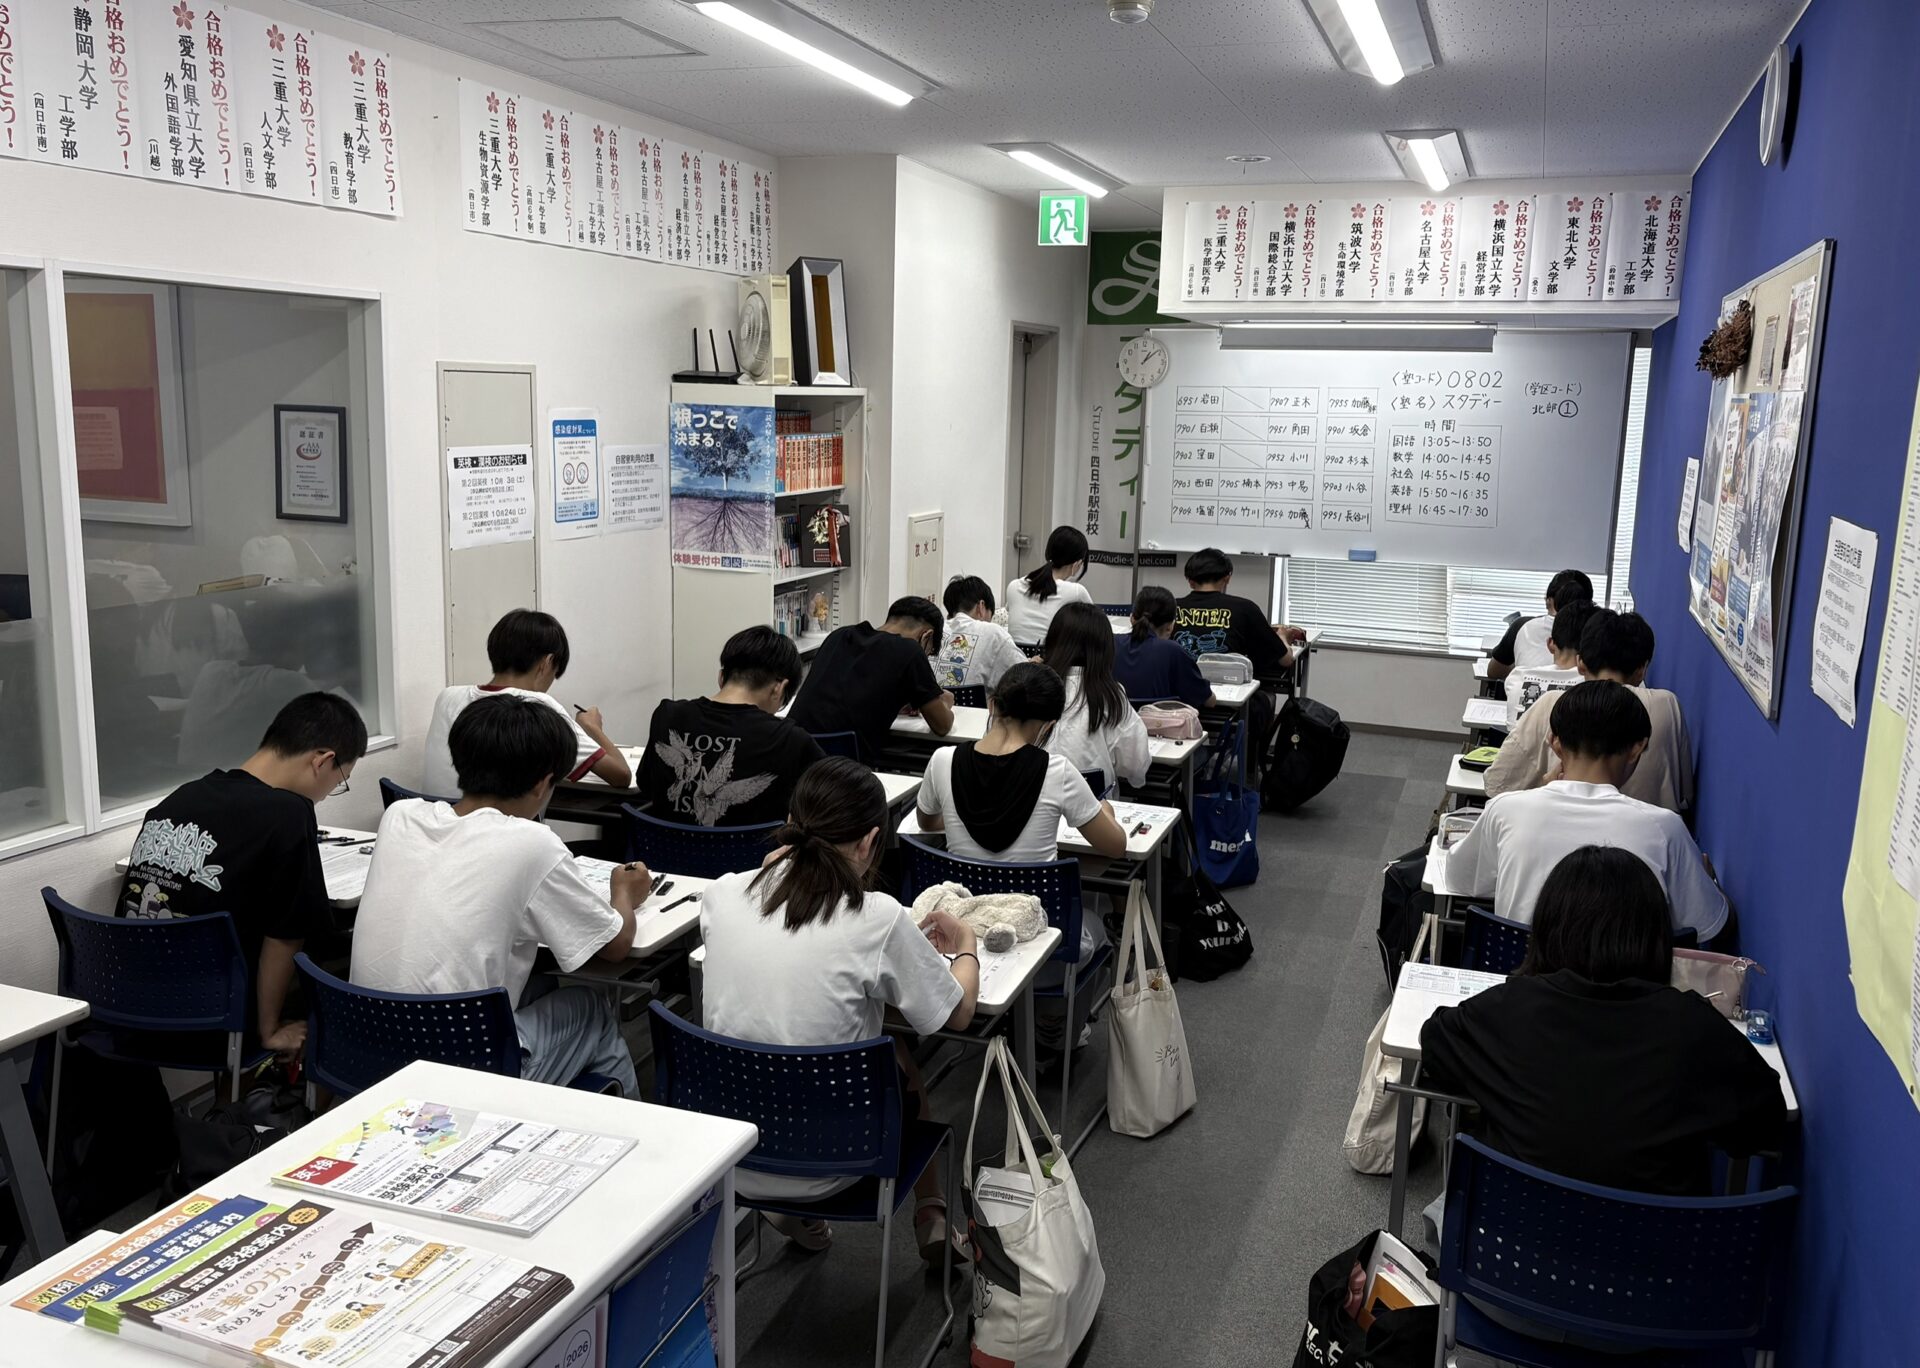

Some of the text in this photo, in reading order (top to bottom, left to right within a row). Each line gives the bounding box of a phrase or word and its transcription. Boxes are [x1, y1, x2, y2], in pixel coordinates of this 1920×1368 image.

[73, 6, 99, 110] 静岡大学
[33, 92, 48, 153] （四日市南）
[58, 94, 79, 160] 工学部
[164, 73, 185, 178] 外国語学部
[178, 35, 206, 179] 愛知県立大学
[204, 10, 233, 186] 合格おめでとう！
[271, 58, 292, 147] 三重大学
[293, 32, 317, 197] 合格おめでとう！
[352, 80, 371, 164] 三重大学
[148, 139, 161, 172] （川越）
[242, 142, 256, 184] （四日市）
[260, 112, 278, 190] 人文学部
[342, 132, 358, 205] 教育学部
[373, 58, 397, 211] 合格おめでとう！
[489, 117, 503, 191] 三重大学
[505, 97, 520, 232] 合格おめでとう！
[545, 134, 556, 204] 三重大学
[329, 161, 341, 200] （四日市）
[478, 131, 491, 228] 生物資源学部
[538, 192, 547, 235] 工学部
[560, 115, 572, 243] 合格おめでとう！
[595, 146, 607, 246] 名古屋工業大学
[608, 129, 620, 251] 合格おめでとう！
[640, 160, 651, 255] 名古屋工業大学
[653, 142, 664, 258] 合格おめでとう！
[693, 155, 702, 266] 合格おめでとう！
[588, 202, 597, 244] 工学部
[683, 173, 691, 261] 名古屋市立大学
[720, 181, 728, 265] 名古屋市立大学
[731, 164, 739, 270] 合格おめでとう！
[1214, 222, 1228, 273] 三重大学
[1233, 205, 1248, 298] 合格おめでとう！
[1302, 203, 1317, 298] 合格おめでとう！
[1348, 222, 1364, 274] 筑波大学
[1369, 203, 1385, 298] 合格おめでとう！
[1438, 201, 1455, 297] 合格おめでとう！
[1511, 200, 1529, 298] 合格おめでとう！
[1563, 216, 1580, 270] 東北大学
[1585, 196, 1605, 297] 合格おめでとう！
[1640, 214, 1658, 282] 北海道大学
[1664, 195, 1683, 297] 合格おめでとう！
[1201, 238, 1213, 295] 医学部医学科
[1266, 231, 1280, 297] 国際総合学部
[1281, 221, 1296, 297] 横浜市立大学
[1335, 242, 1347, 297] 生命環境学部
[1404, 268, 1415, 296] 法学部
[1417, 220, 1432, 285] 名古屋大学
[1474, 251, 1487, 296] 経営学部
[1488, 218, 1506, 297] 横浜国立大学
[1546, 260, 1560, 295] 文学部
[1623, 261, 1637, 295] 工学部
[1447, 370, 1503, 389] 0802
[674, 408, 738, 430] 根っこで
[674, 431, 722, 448] 決まる。
[1392, 435, 1416, 448] 国語
[1390, 467, 1414, 480] 社会
[1390, 484, 1413, 497] 英語
[1392, 452, 1414, 464] 数学
[1086, 455, 1100, 535] 四日市駅前校
[1389, 503, 1412, 515] 理科
[673, 552, 720, 567] 体験受付中
[683, 732, 741, 753] LOST
[291, 1158, 339, 1182] 英検
[162, 1212, 245, 1261] 受検案内
[214, 1223, 298, 1271] 受検案内
[566, 1341, 589, 1367] 2026
